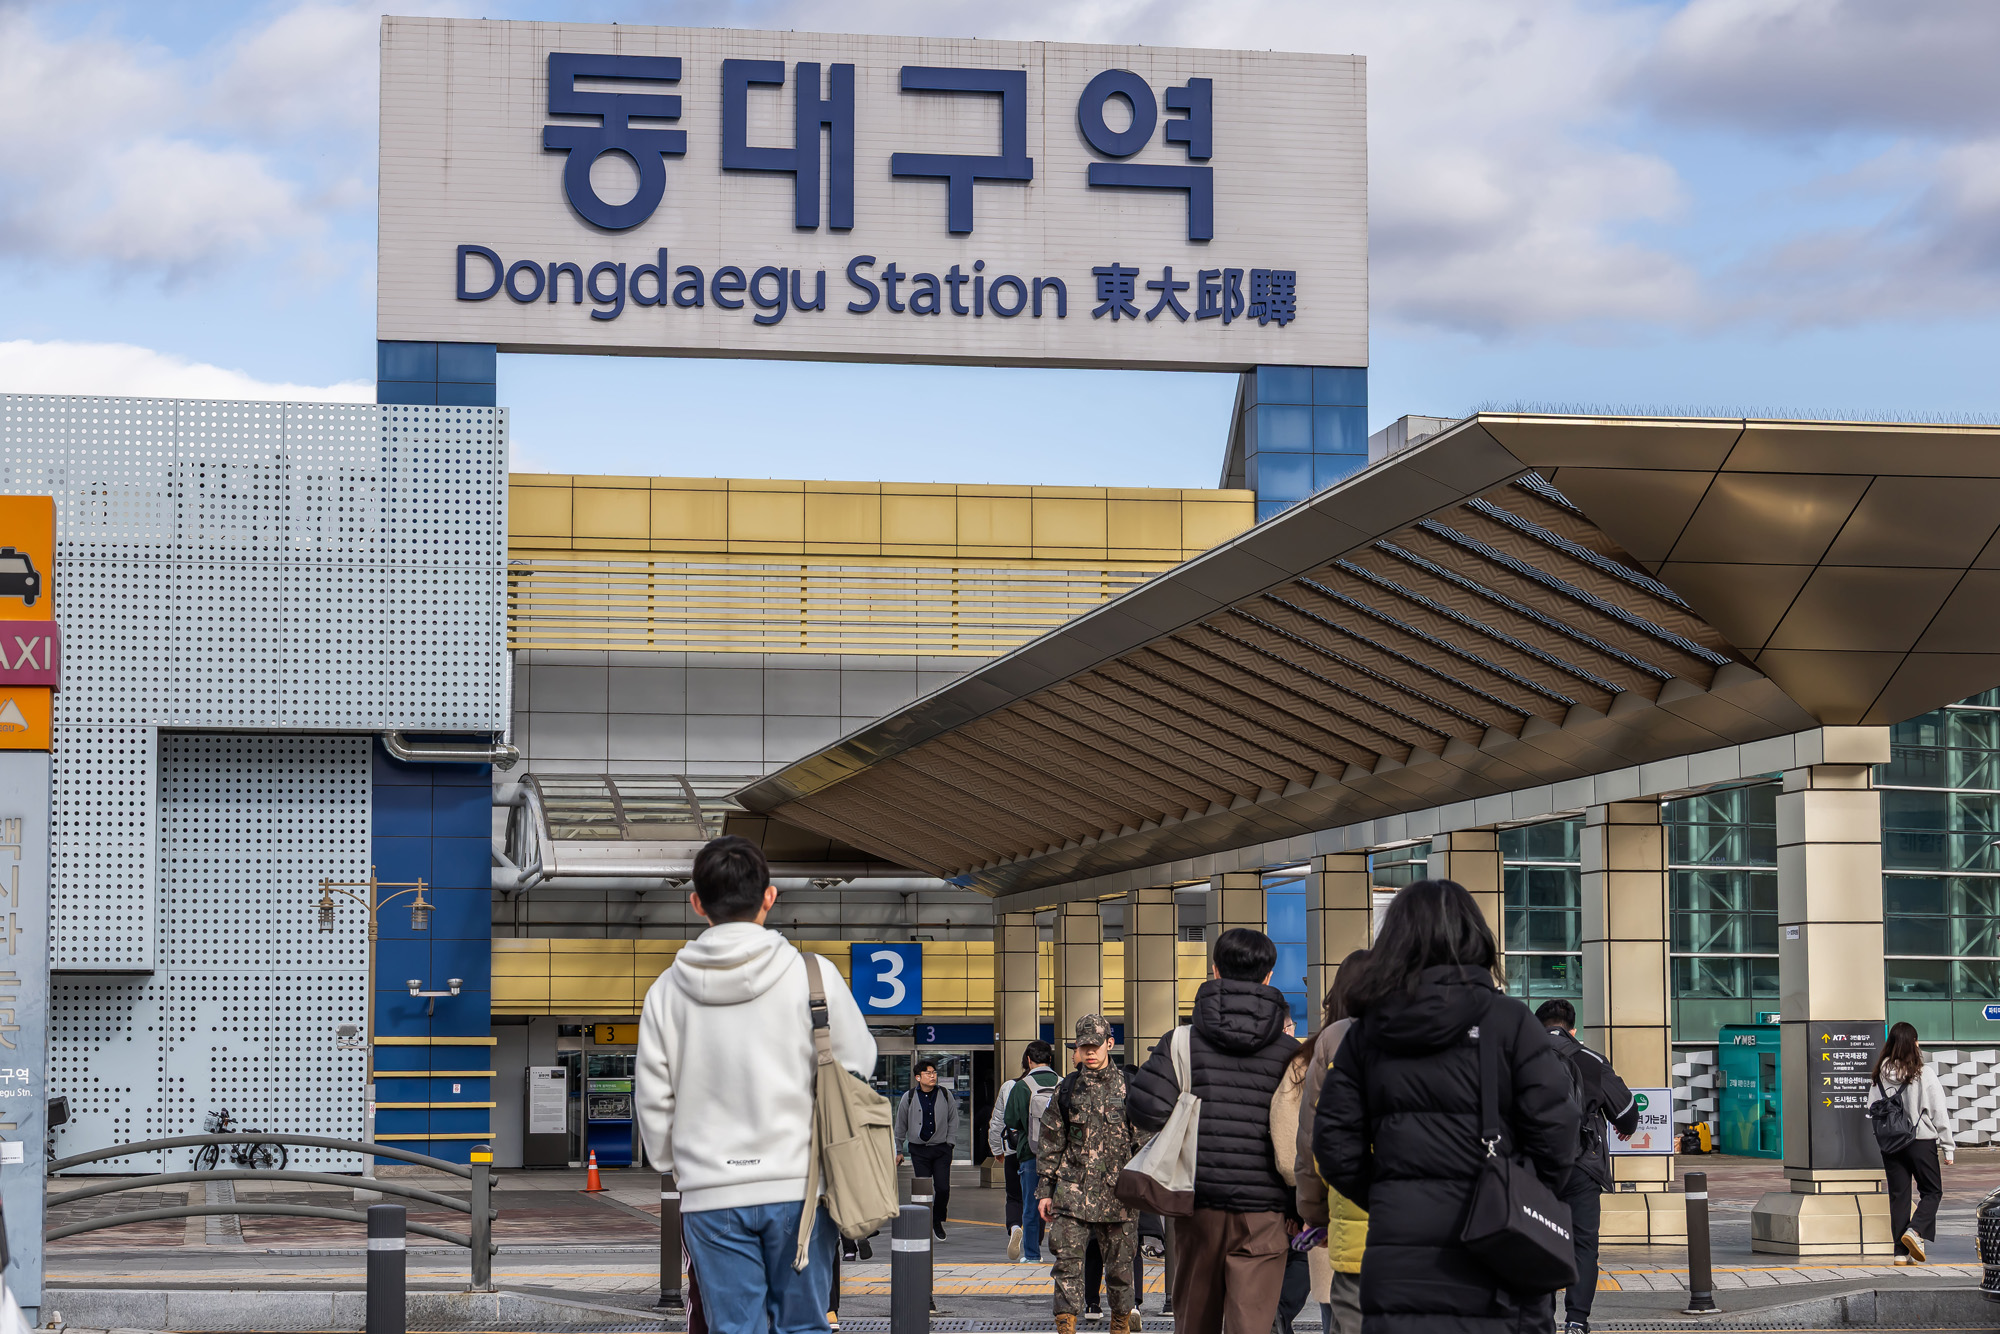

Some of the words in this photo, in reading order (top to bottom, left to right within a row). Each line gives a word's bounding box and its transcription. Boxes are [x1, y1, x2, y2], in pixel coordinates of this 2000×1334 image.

[543, 52, 1213, 241] 동대구역
[456, 245, 826, 325] Dongdaegu
[847, 255, 1067, 318] Station
[1092, 262, 1298, 326] 東大邱驛
[868, 950, 906, 1008] 3
[606, 1026, 615, 1042] 3
[926, 1026, 936, 1042] 3
[17, 1088, 33, 1097] Stn.
[1644, 1114, 1668, 1125] 가는길
